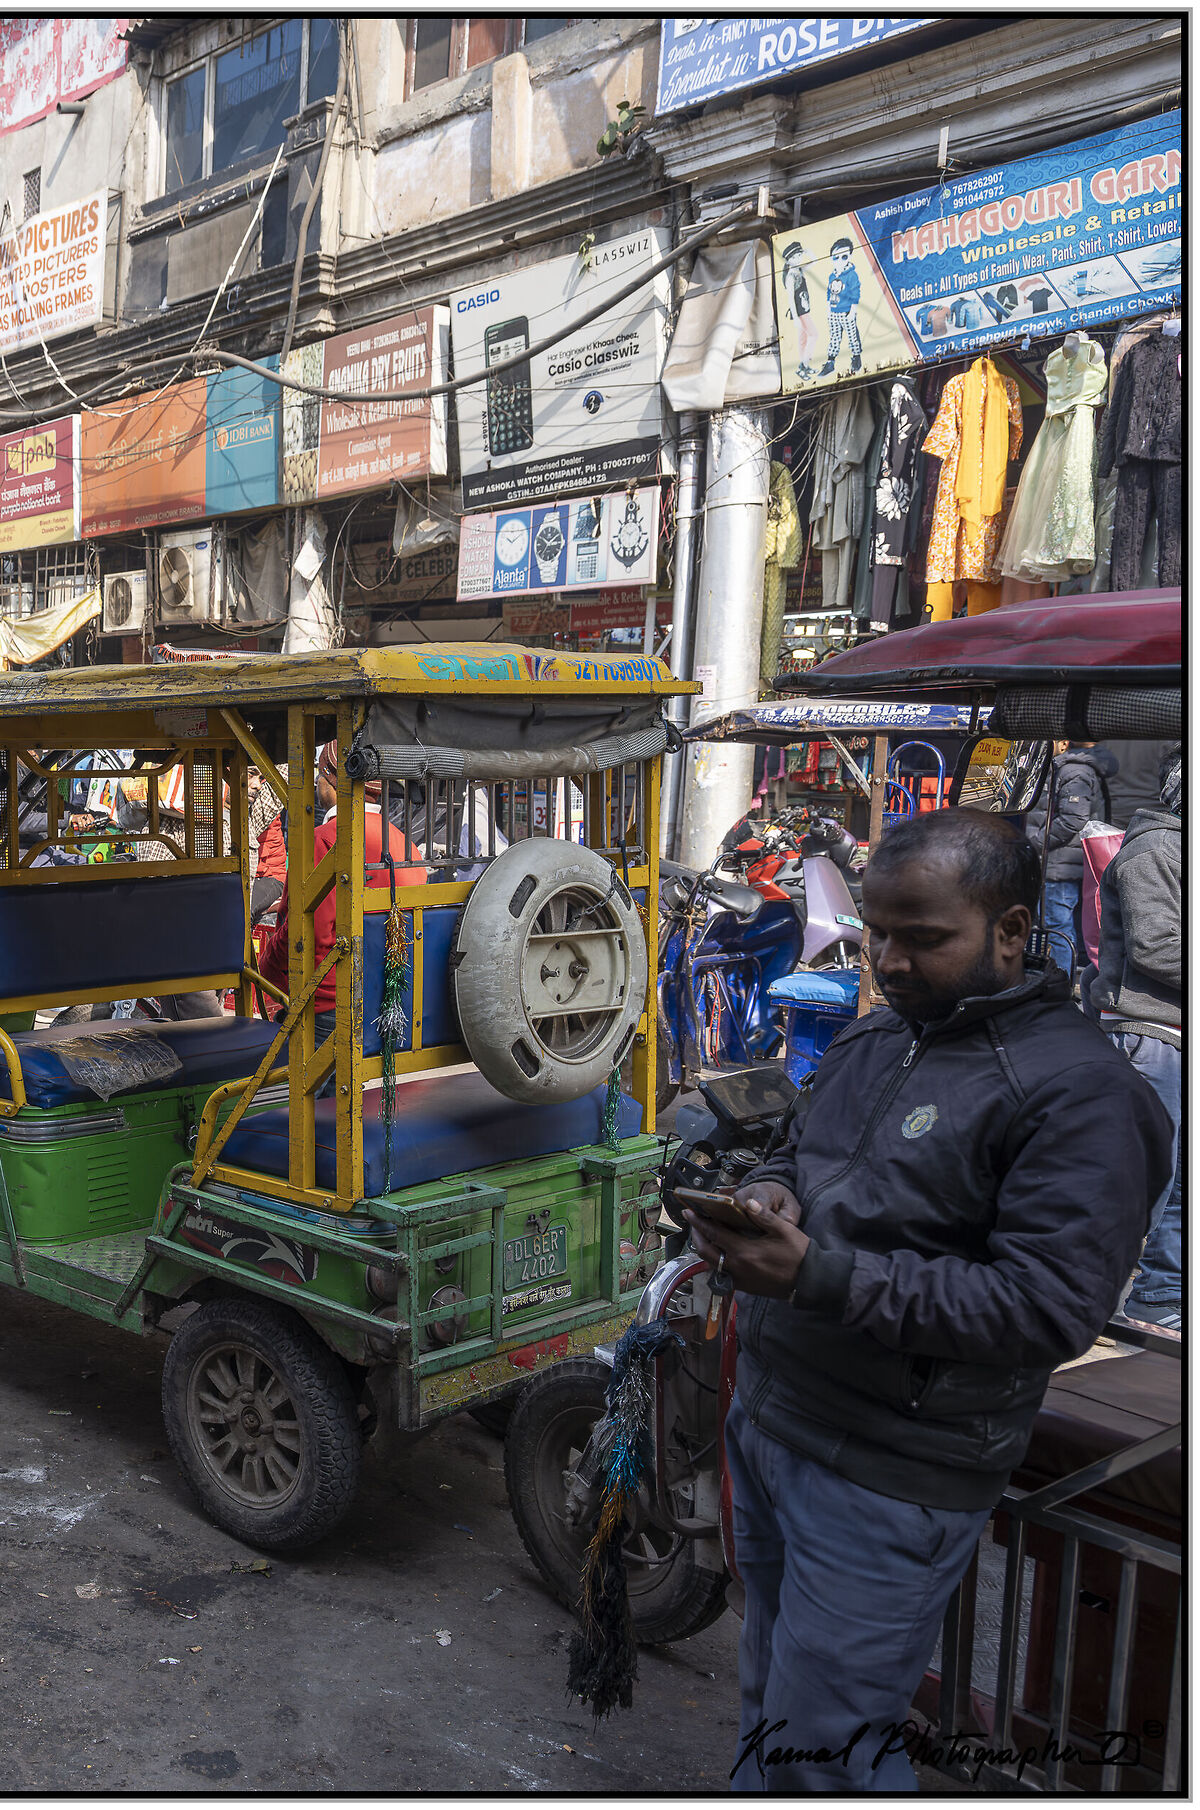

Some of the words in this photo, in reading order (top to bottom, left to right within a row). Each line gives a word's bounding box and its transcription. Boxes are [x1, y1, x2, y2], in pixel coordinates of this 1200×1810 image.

[664, 52, 732, 107] Specialist
[757, 19, 840, 72] ROSE
[952, 172, 1004, 196] 7678262907
[953, 185, 1004, 209] 9910447972
[874, 205, 904, 221] Ashish
[904, 195, 932, 212] Dubey
[890, 177, 1083, 265] MAHAGOURI
[25, 200, 99, 257] PICTURES
[962, 224, 1076, 264] Wholesale
[1085, 215, 1102, 232] &
[34, 237, 98, 276] PICTURERS
[900, 286, 923, 302] Deals
[924, 284, 933, 296] in
[940, 277, 952, 292] All
[953, 270, 978, 291] Types
[980, 267, 990, 282] of
[991, 259, 1021, 282] Family
[1022, 251, 1049, 275] Wear,
[1051, 244, 1077, 264] Pant,
[1079, 237, 1105, 258] Shirt,
[55, 284, 93, 311] FRAMES
[457, 289, 500, 313] CASIO
[962, 326, 1017, 348] Fatehpuri
[1070, 302, 1124, 323] Chandni
[372, 353, 391, 392] DRY
[392, 342, 427, 389] FRUITS
[548, 359, 582, 377] Casio
[326, 405, 360, 434] Wholesale
[229, 427, 248, 443] IDBI
[250, 424, 270, 439] BANK
[27, 436, 54, 472] pnb
[525, 460, 560, 475] Authorised
[561, 455, 585, 467] Dealer:
[469, 487, 485, 497] NEW
[486, 481, 515, 493] ASHOKA
[517, 475, 542, 488] WATCH
[544, 469, 584, 482] COMPANY,
[585, 464, 597, 473] PH
[1, 501, 21, 519] punjab
[21, 495, 45, 511] national
[46, 491, 61, 505] bank
[179, 505, 202, 517] BRANCH
[470, 523, 487, 535] NEW
[463, 535, 492, 550] ASHOKA
[464, 550, 489, 563] WATCH
[460, 563, 493, 578] COMPANY
[494, 567, 526, 586] Ajanta
[781, 704, 932, 718] AUTOMOBILES
[212, 1226, 234, 1239] Super
[515, 1231, 559, 1262] DL6ER
[521, 1254, 556, 1281] 4402
